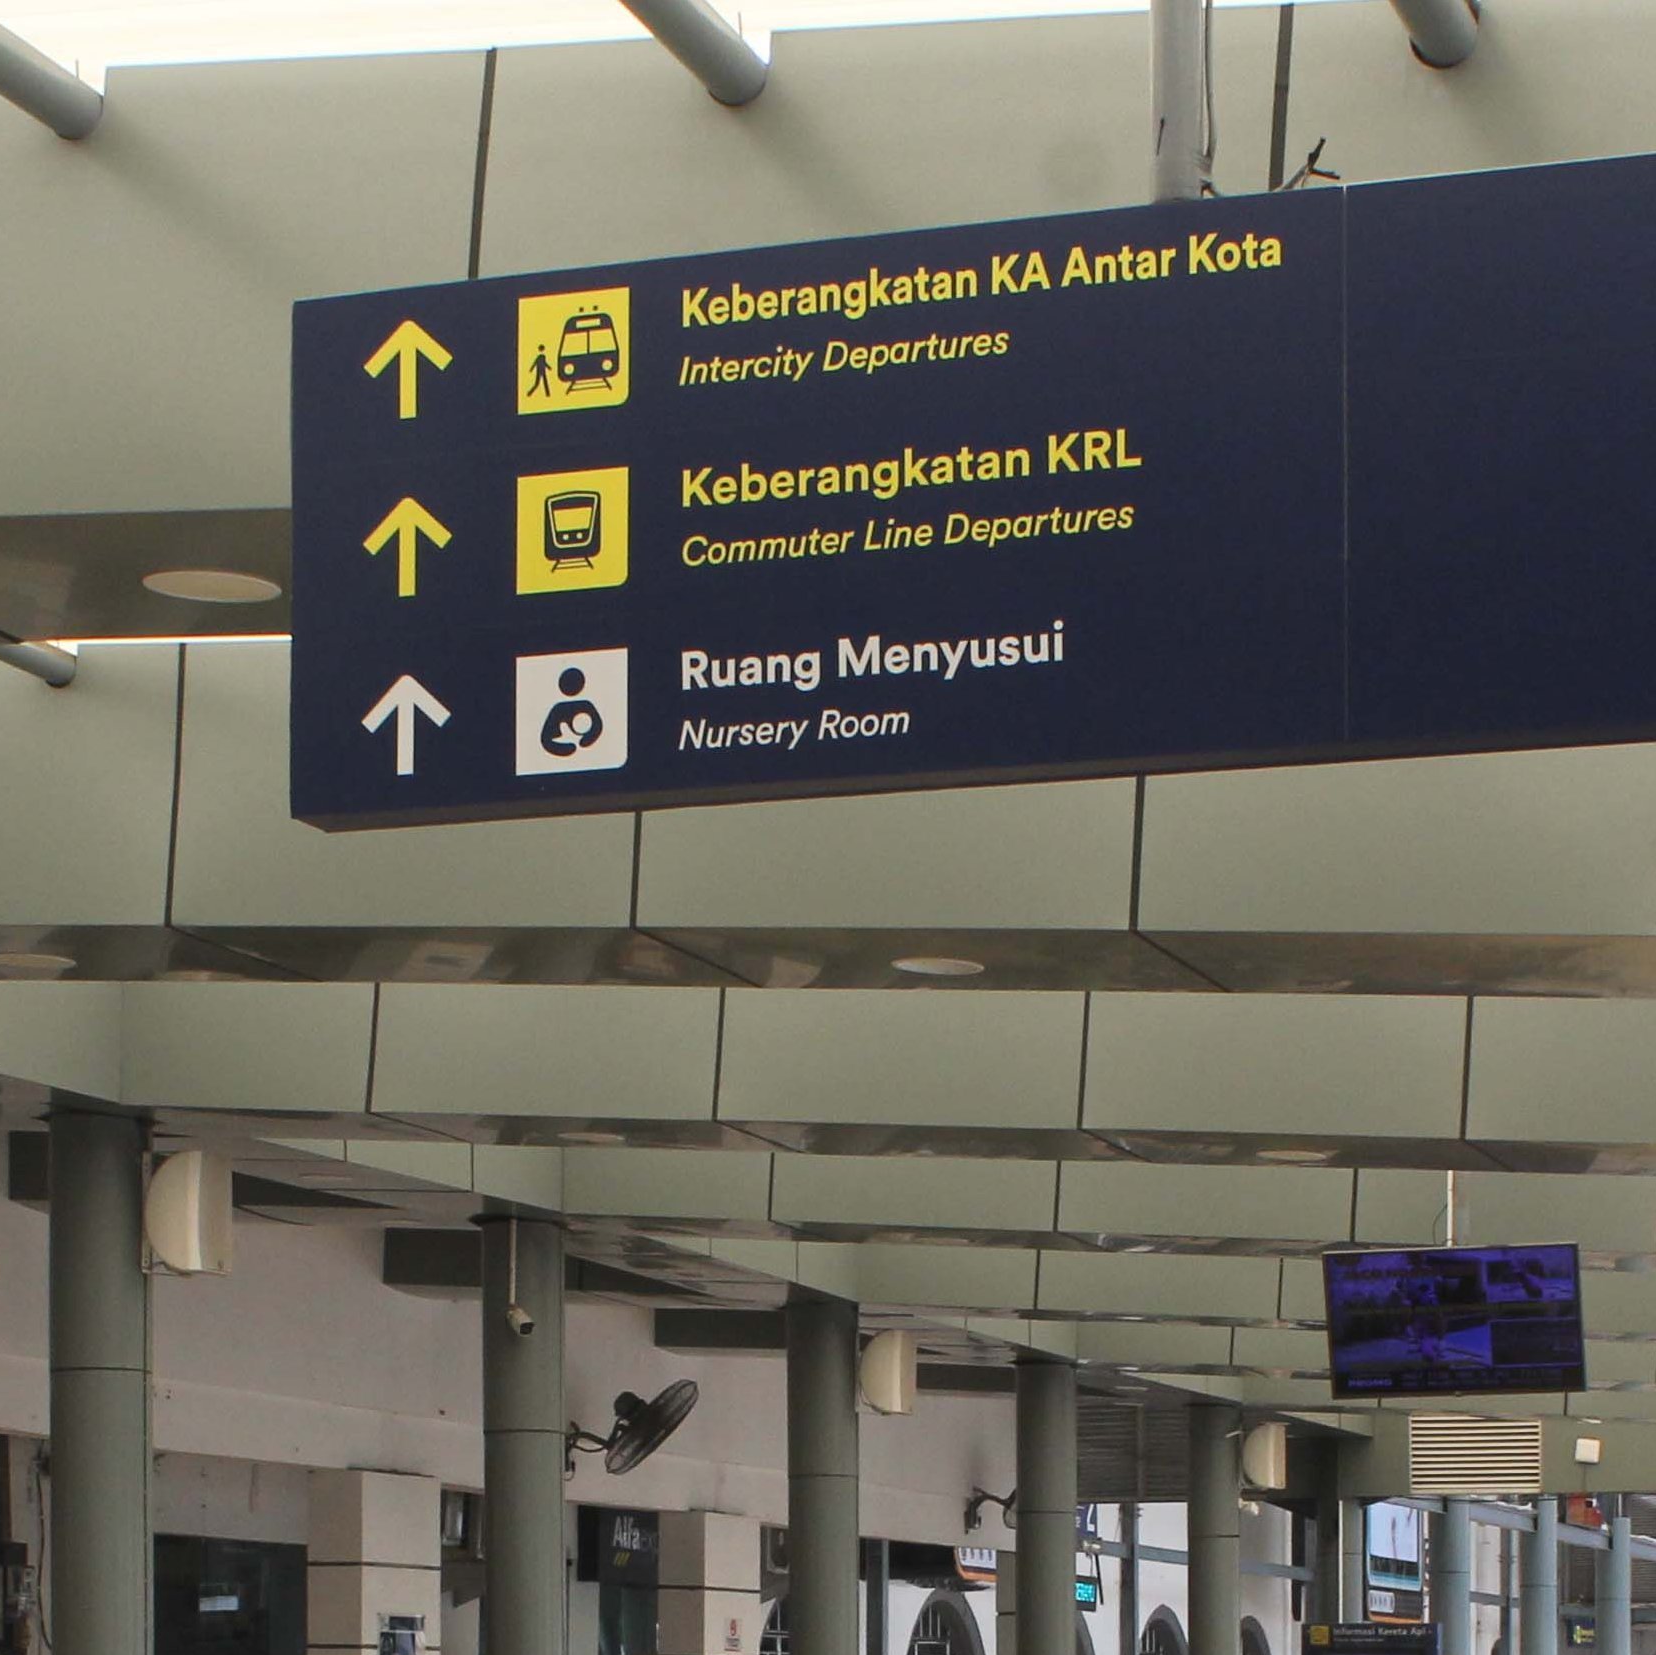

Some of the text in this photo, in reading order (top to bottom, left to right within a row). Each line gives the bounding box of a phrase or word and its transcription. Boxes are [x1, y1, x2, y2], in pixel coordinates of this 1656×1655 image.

[682, 232, 1282, 328] Keberangkatan KA Antar Kota
[679, 325, 1010, 386] Intercity Departures
[682, 428, 1142, 508] Keberangkatan KRL
[682, 503, 1135, 567] Commuter Line Departures
[681, 619, 1064, 692] Ruang Menyusui
[678, 706, 910, 751] Nursery Room
